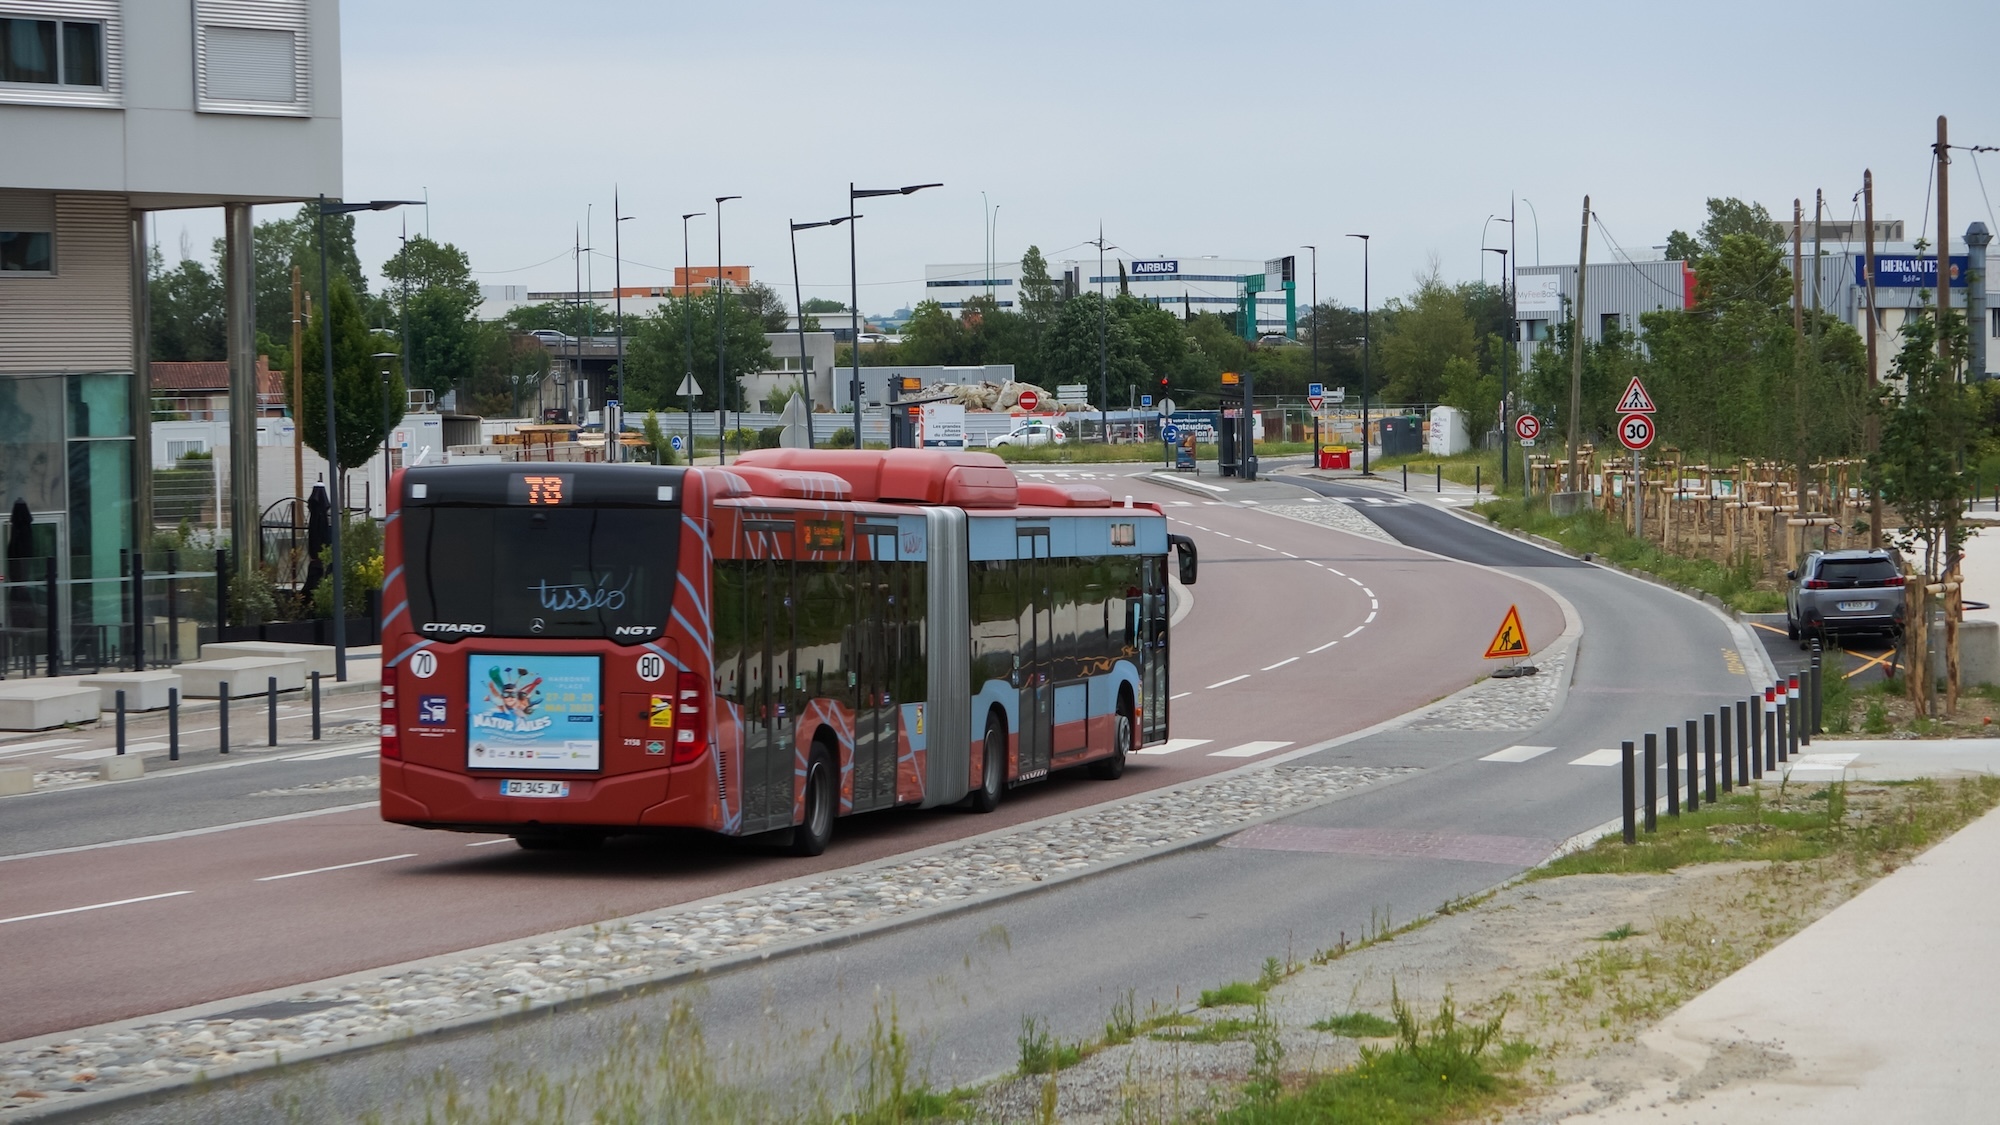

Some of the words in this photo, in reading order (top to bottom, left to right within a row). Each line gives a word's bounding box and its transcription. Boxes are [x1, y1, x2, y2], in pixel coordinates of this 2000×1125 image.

[1136, 262, 1175, 273] AIRBUS
[1626, 423, 1648, 439] 30
[527, 572, 633, 612] tisséo
[422, 622, 486, 633] CITARO
[615, 626, 657, 635] NGT
[416, 653, 432, 675] 70
[641, 656, 660, 677] 80
